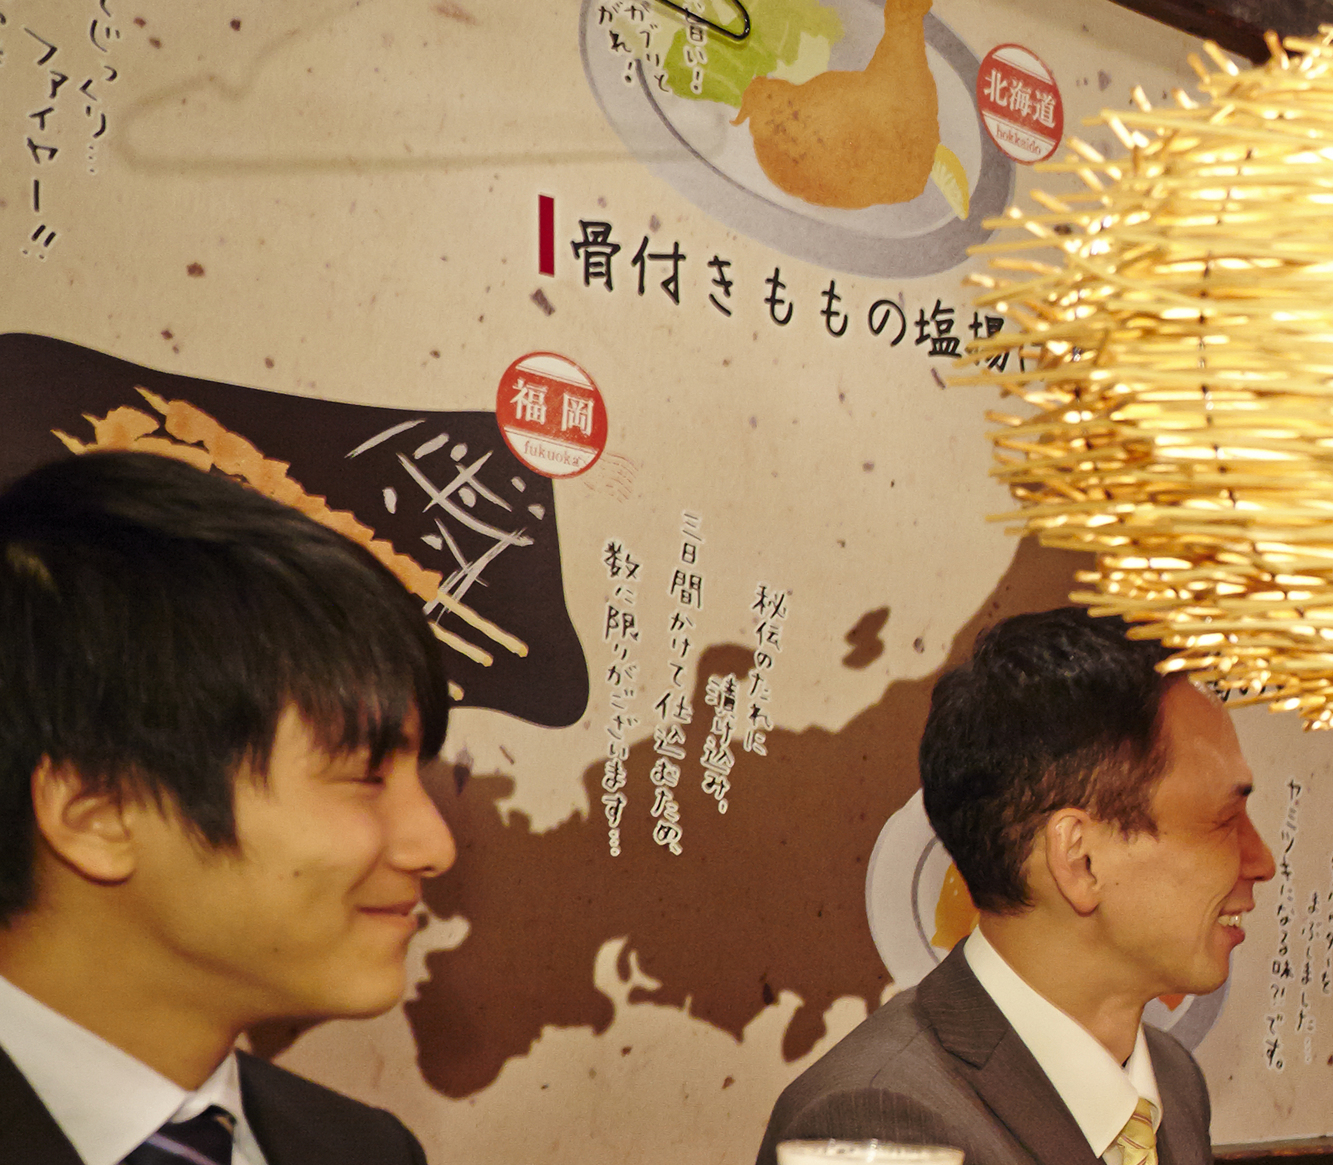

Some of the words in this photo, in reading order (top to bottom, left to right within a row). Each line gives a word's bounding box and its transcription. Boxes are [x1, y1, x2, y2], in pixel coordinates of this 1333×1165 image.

[80, 0, 120, 172] じっくり…
[984, 70, 1055, 128] 北海道
[995, 125, 1041, 155] hokkaido
[570, 219, 1024, 373] 骨付きももの塩揚
[510, 378, 594, 436] 福岡
[524, 440, 581, 467] fukuoka
[744, 586, 786, 756] 秘伝のたれに
